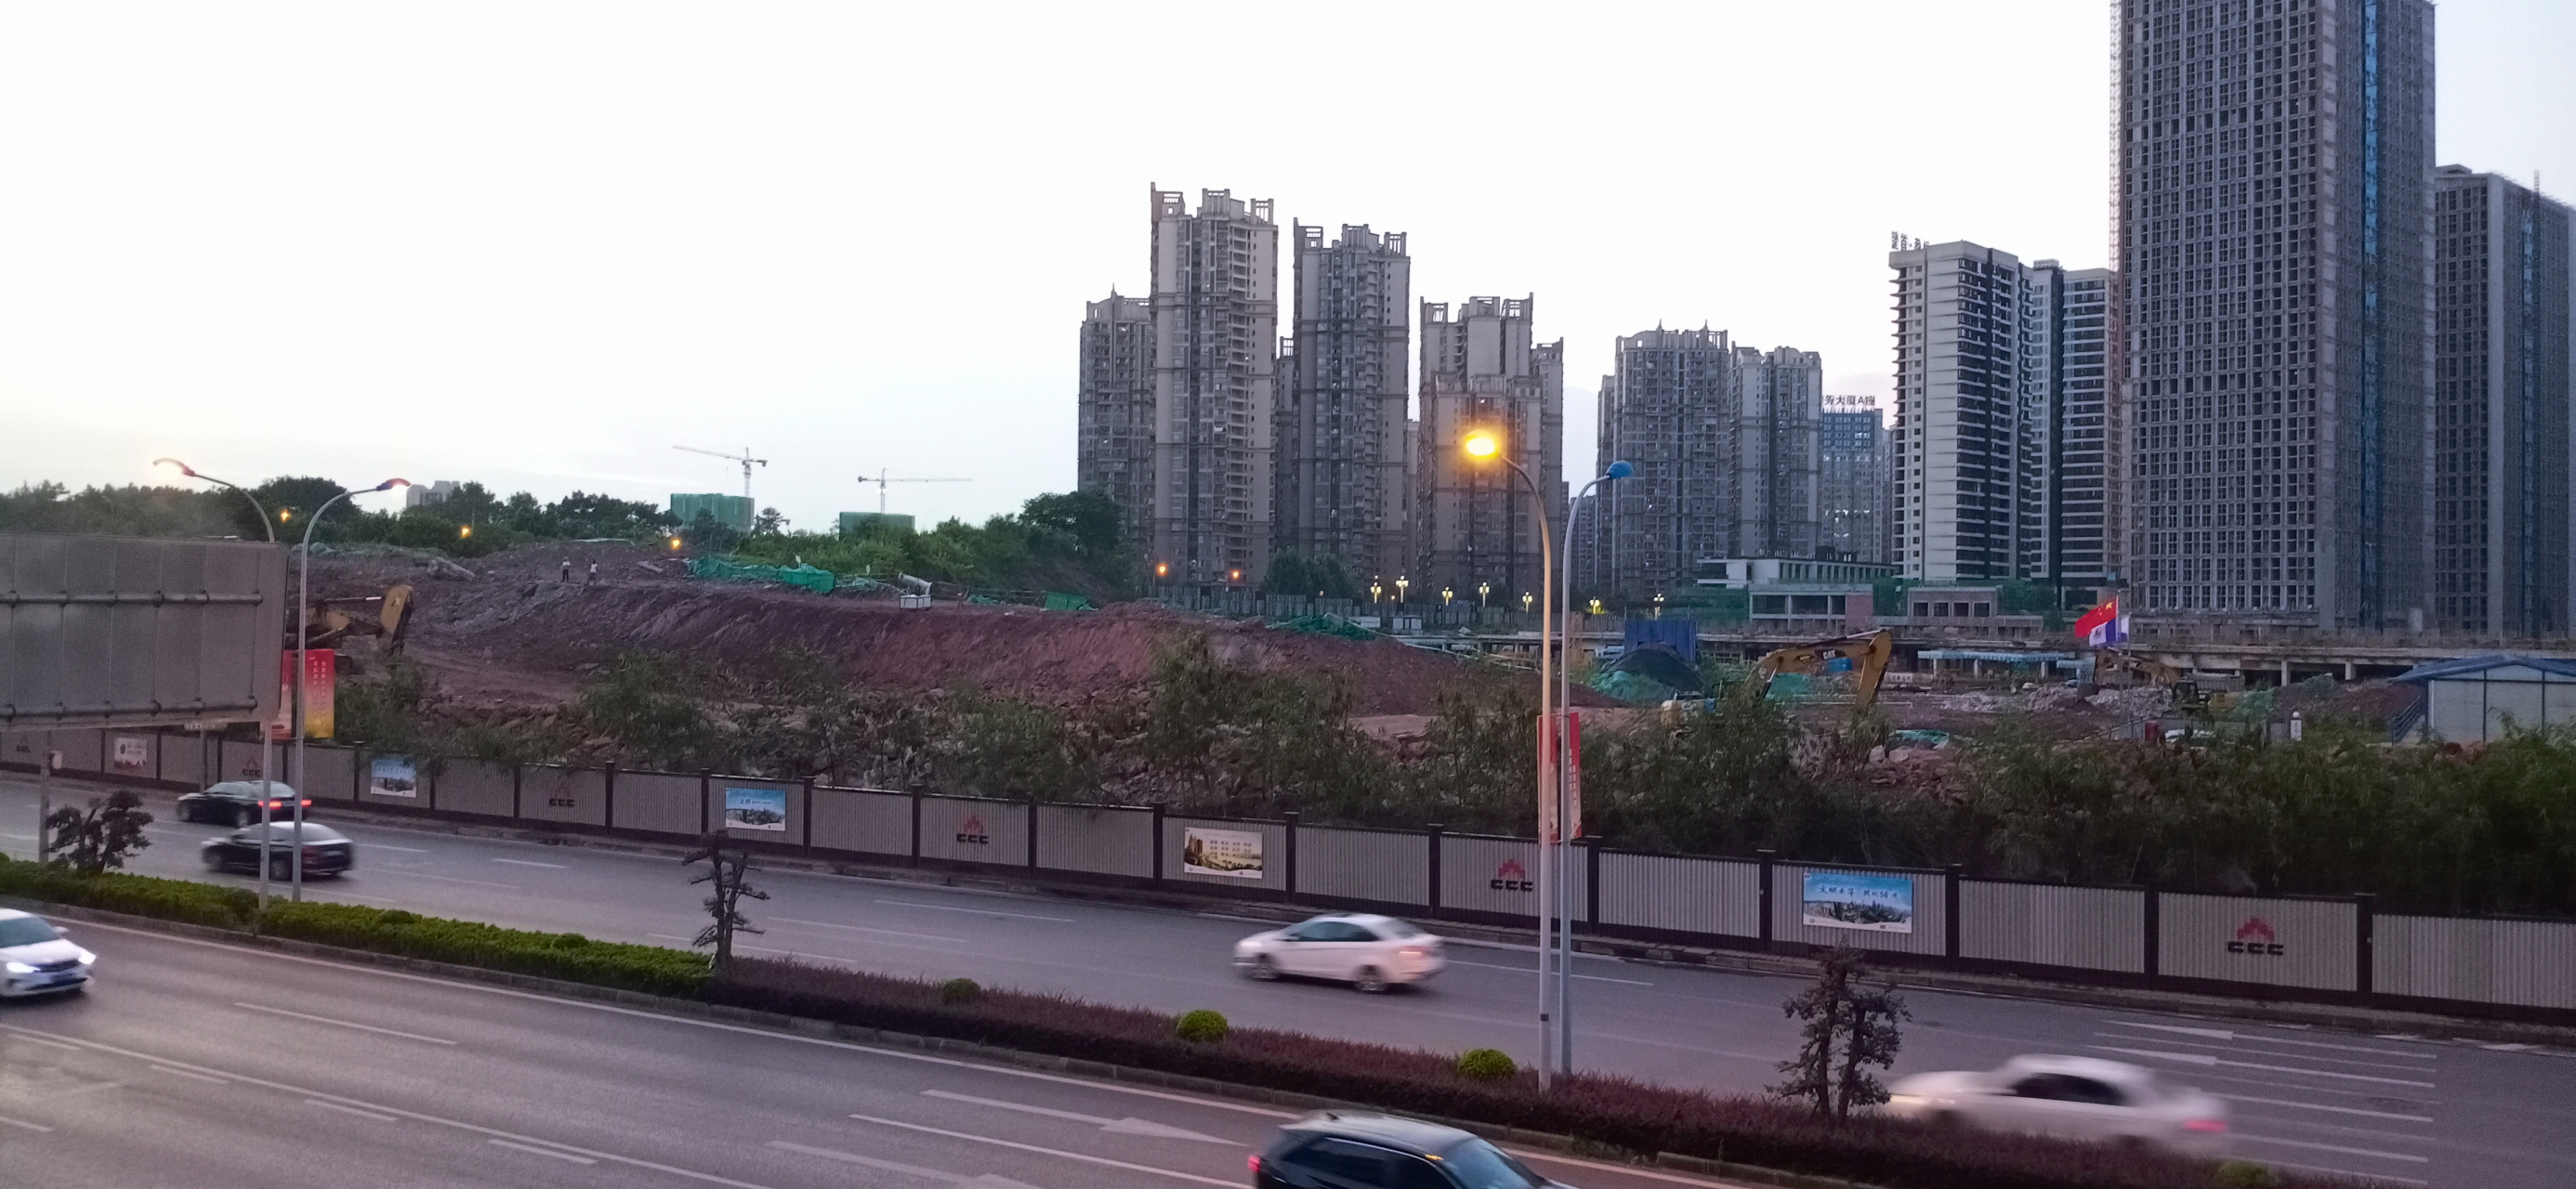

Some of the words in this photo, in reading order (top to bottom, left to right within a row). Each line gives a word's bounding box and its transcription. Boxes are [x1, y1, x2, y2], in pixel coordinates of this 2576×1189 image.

[1821, 395, 1875, 405] 务大厦A座
[1822, 649, 1836, 660] CAT
